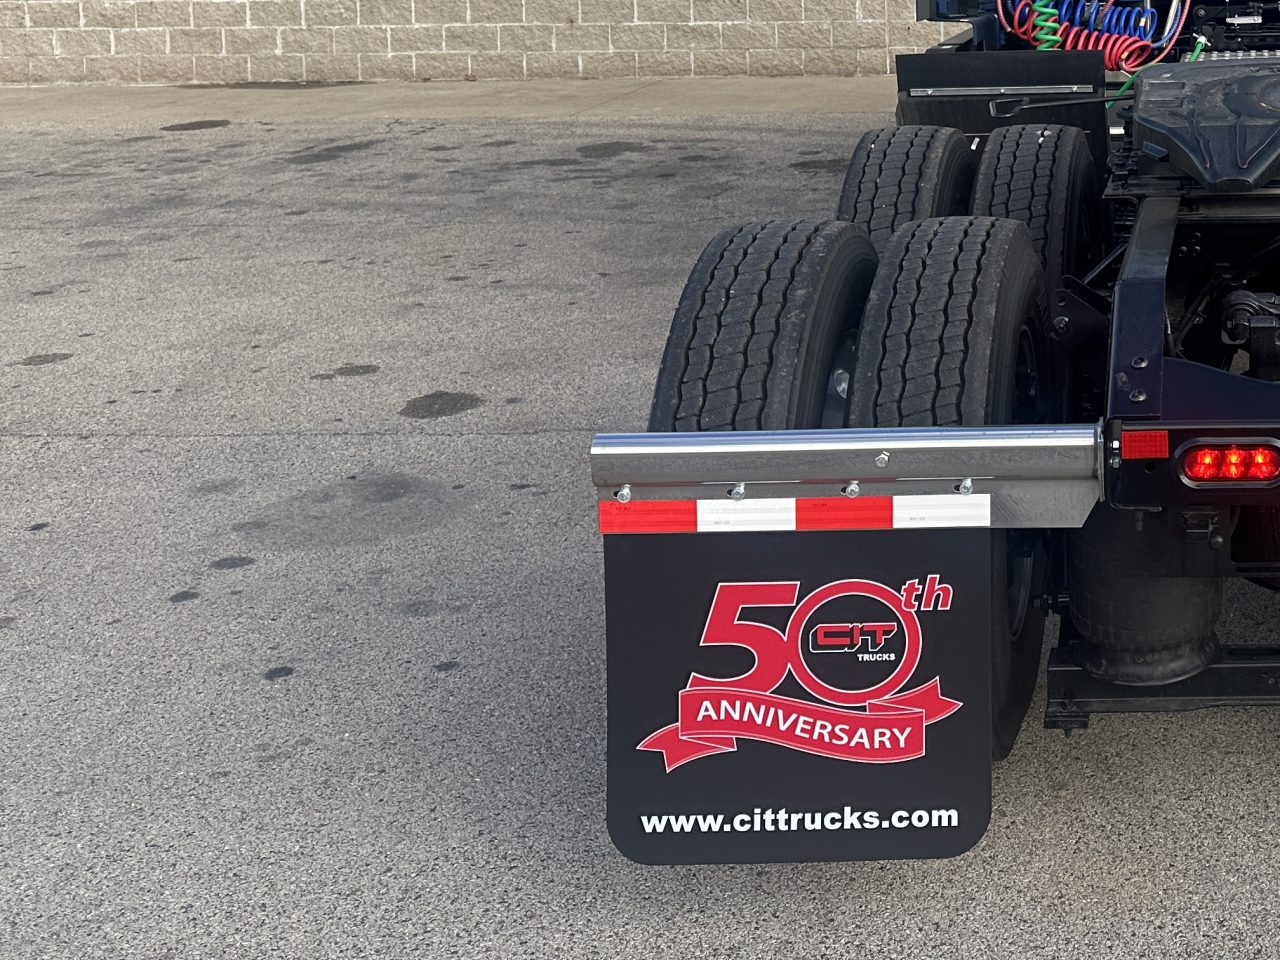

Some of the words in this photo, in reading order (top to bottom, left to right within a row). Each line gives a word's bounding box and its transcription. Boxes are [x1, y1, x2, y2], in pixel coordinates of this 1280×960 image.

[687, 575, 953, 706] 50th
[811, 623, 897, 650] CIT
[857, 653, 896, 662] TRUCKS
[696, 699, 912, 749] ANNIVERSARY
[641, 806, 959, 833] www.cittrucks.com
